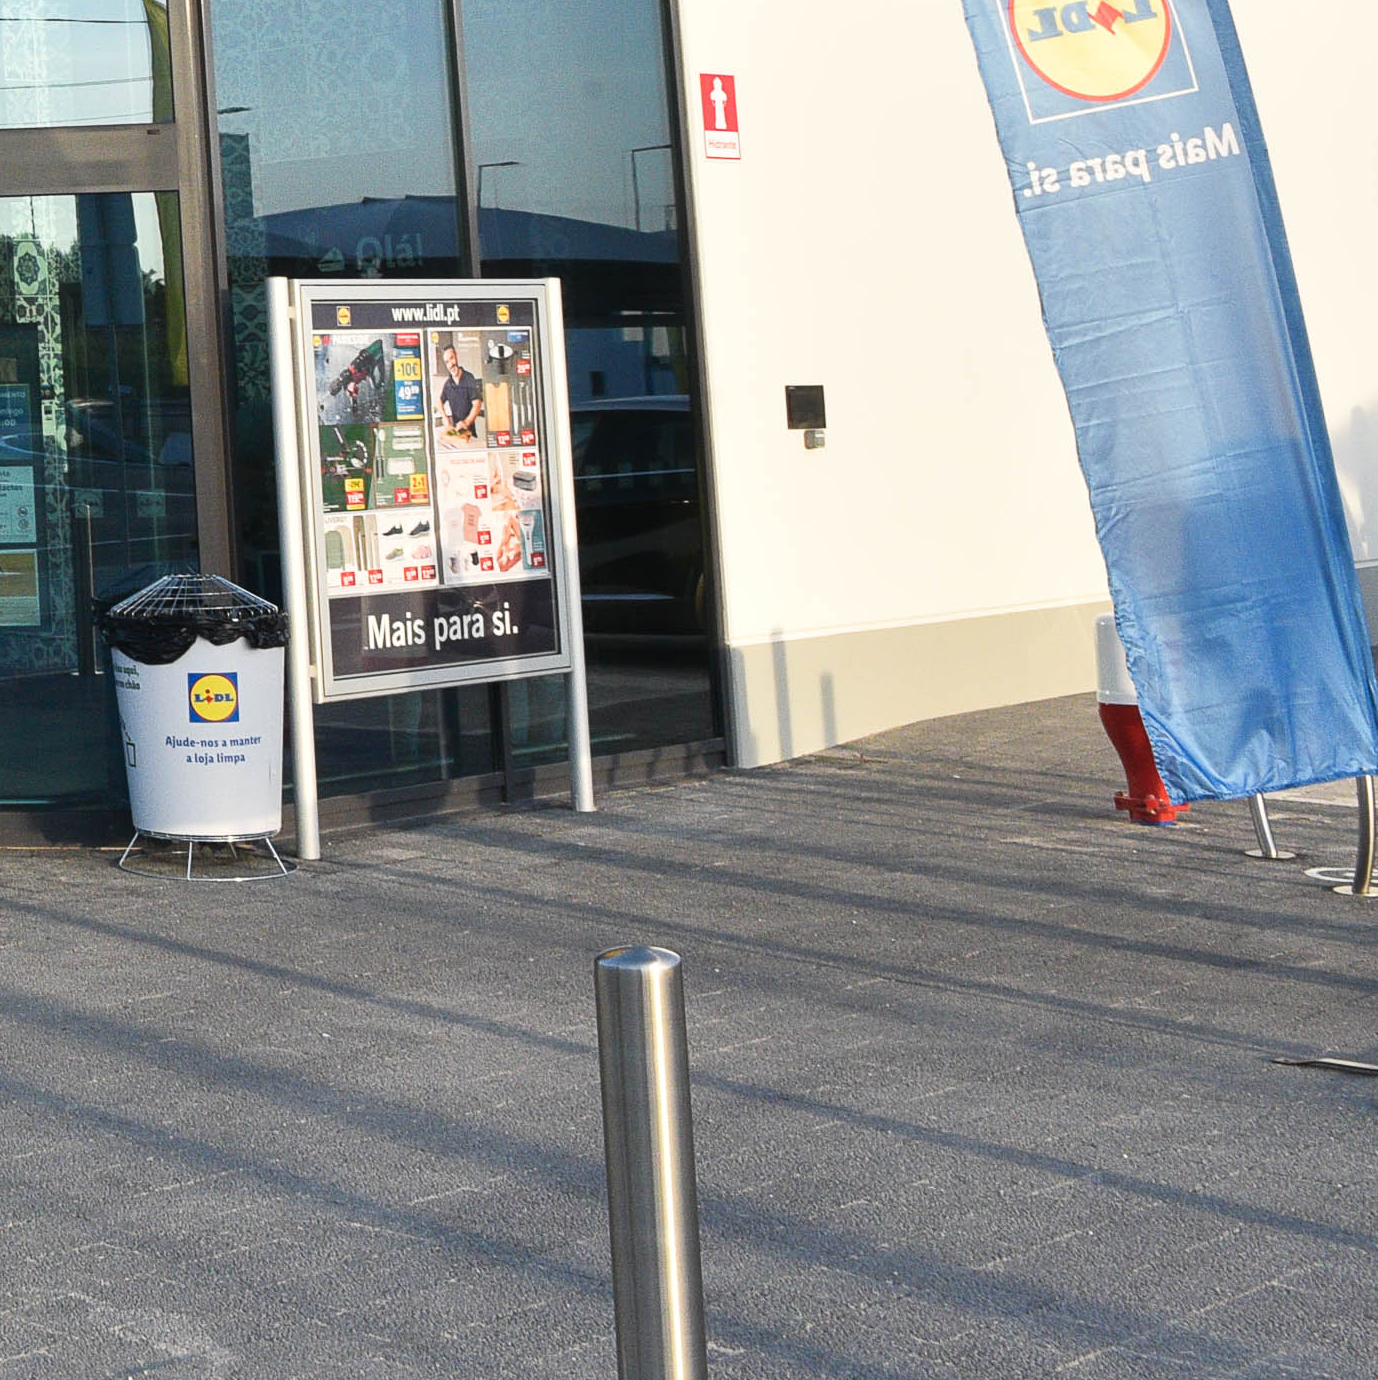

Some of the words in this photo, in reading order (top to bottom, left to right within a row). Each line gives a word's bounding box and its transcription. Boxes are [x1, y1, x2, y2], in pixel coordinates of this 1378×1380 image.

[392, 303, 460, 325] www.lidl.pt
[367, 611, 426, 650] Mais
[434, 613, 485, 650] para
[492, 601, 519, 637] si.
[165, 735, 219, 748] Ajude-nos
[221, 739, 227, 747] a
[229, 735, 261, 747] manter
[194, 753, 214, 765] loja
[217, 753, 245, 765] limpa
